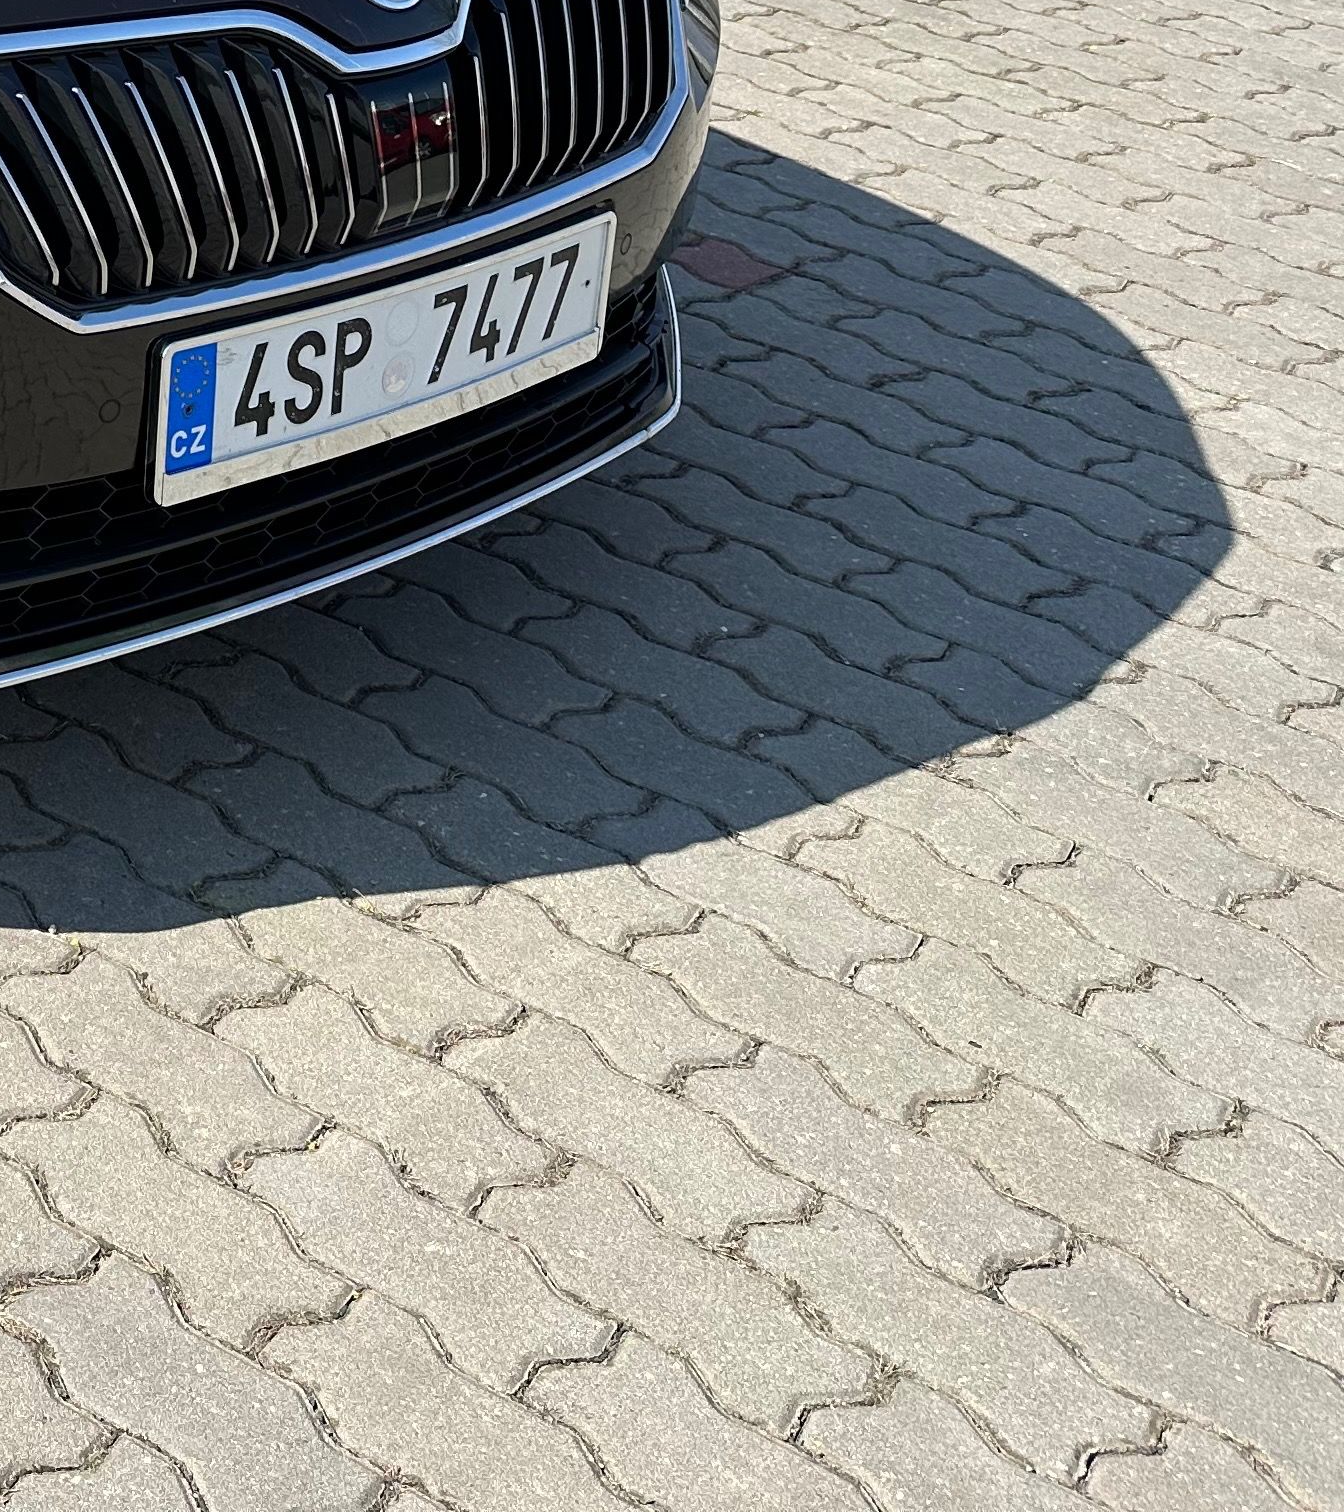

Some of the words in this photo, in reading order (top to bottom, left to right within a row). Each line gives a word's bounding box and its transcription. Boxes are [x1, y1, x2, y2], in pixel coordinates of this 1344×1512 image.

[234, 316, 372, 437] 4SP
[427, 243, 580, 385] 7477
[170, 424, 207, 459] CZ
